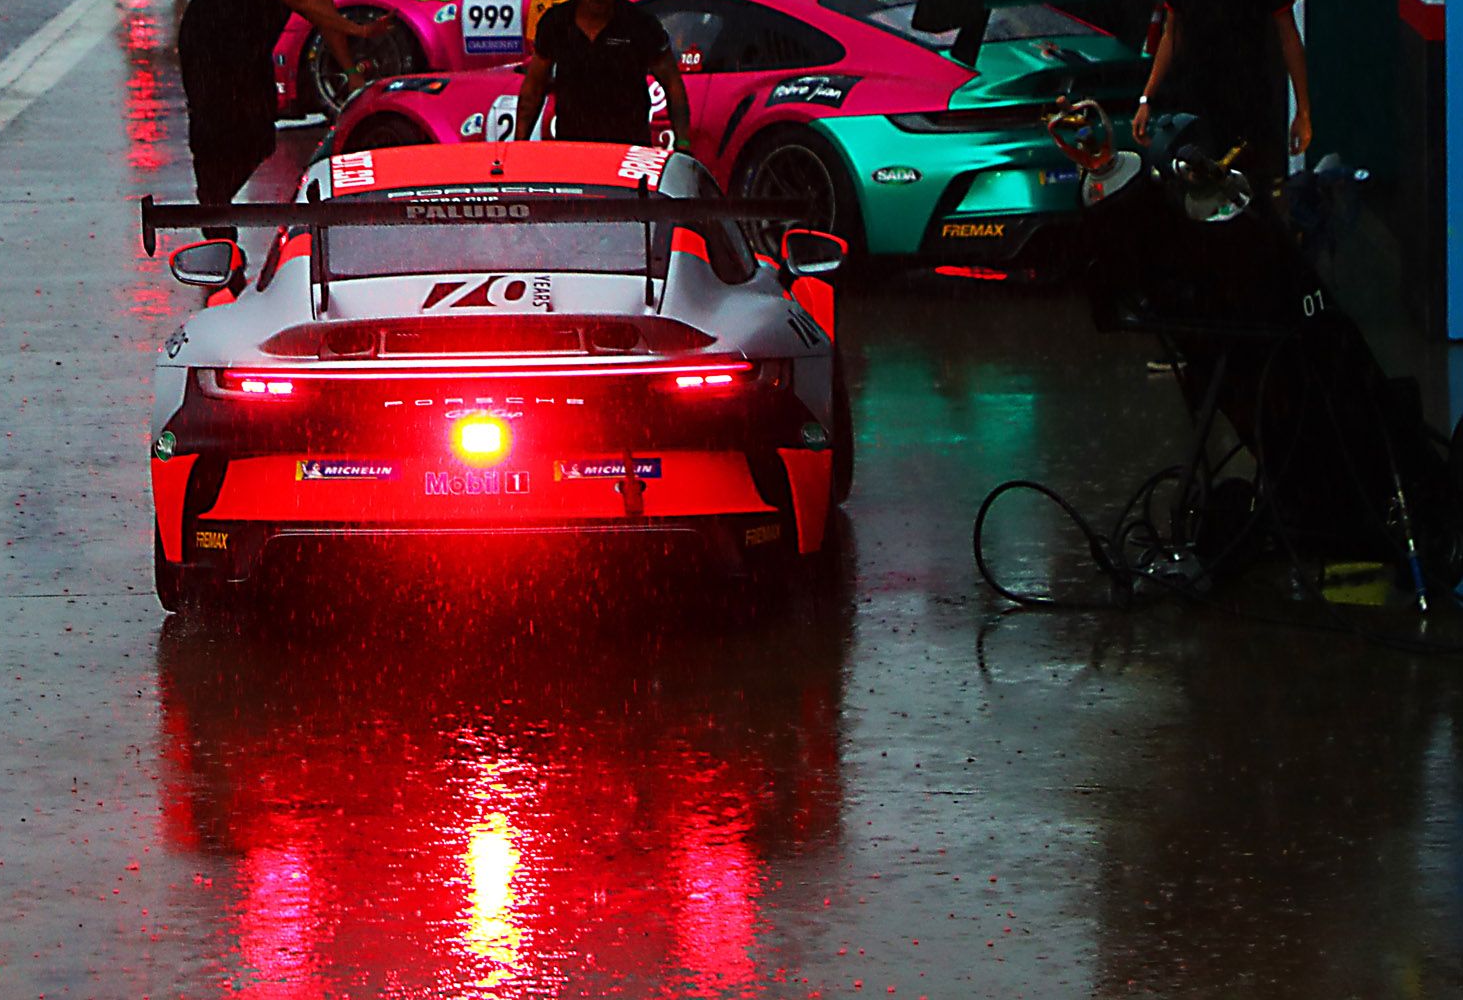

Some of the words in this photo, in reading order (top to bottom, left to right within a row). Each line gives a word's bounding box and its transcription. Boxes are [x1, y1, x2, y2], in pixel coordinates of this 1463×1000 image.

[469, 5, 514, 29] 999
[876, 170, 917, 181] SADA
[406, 204, 530, 219] PALUDO
[942, 223, 1006, 238] FREMAX
[532, 275, 551, 308] YEARS
[384, 397, 584, 408] PORSCHE
[323, 466, 393, 475] MICHELIN
[425, 471, 500, 496] Mobil
[196, 531, 229, 550] FREMAX
